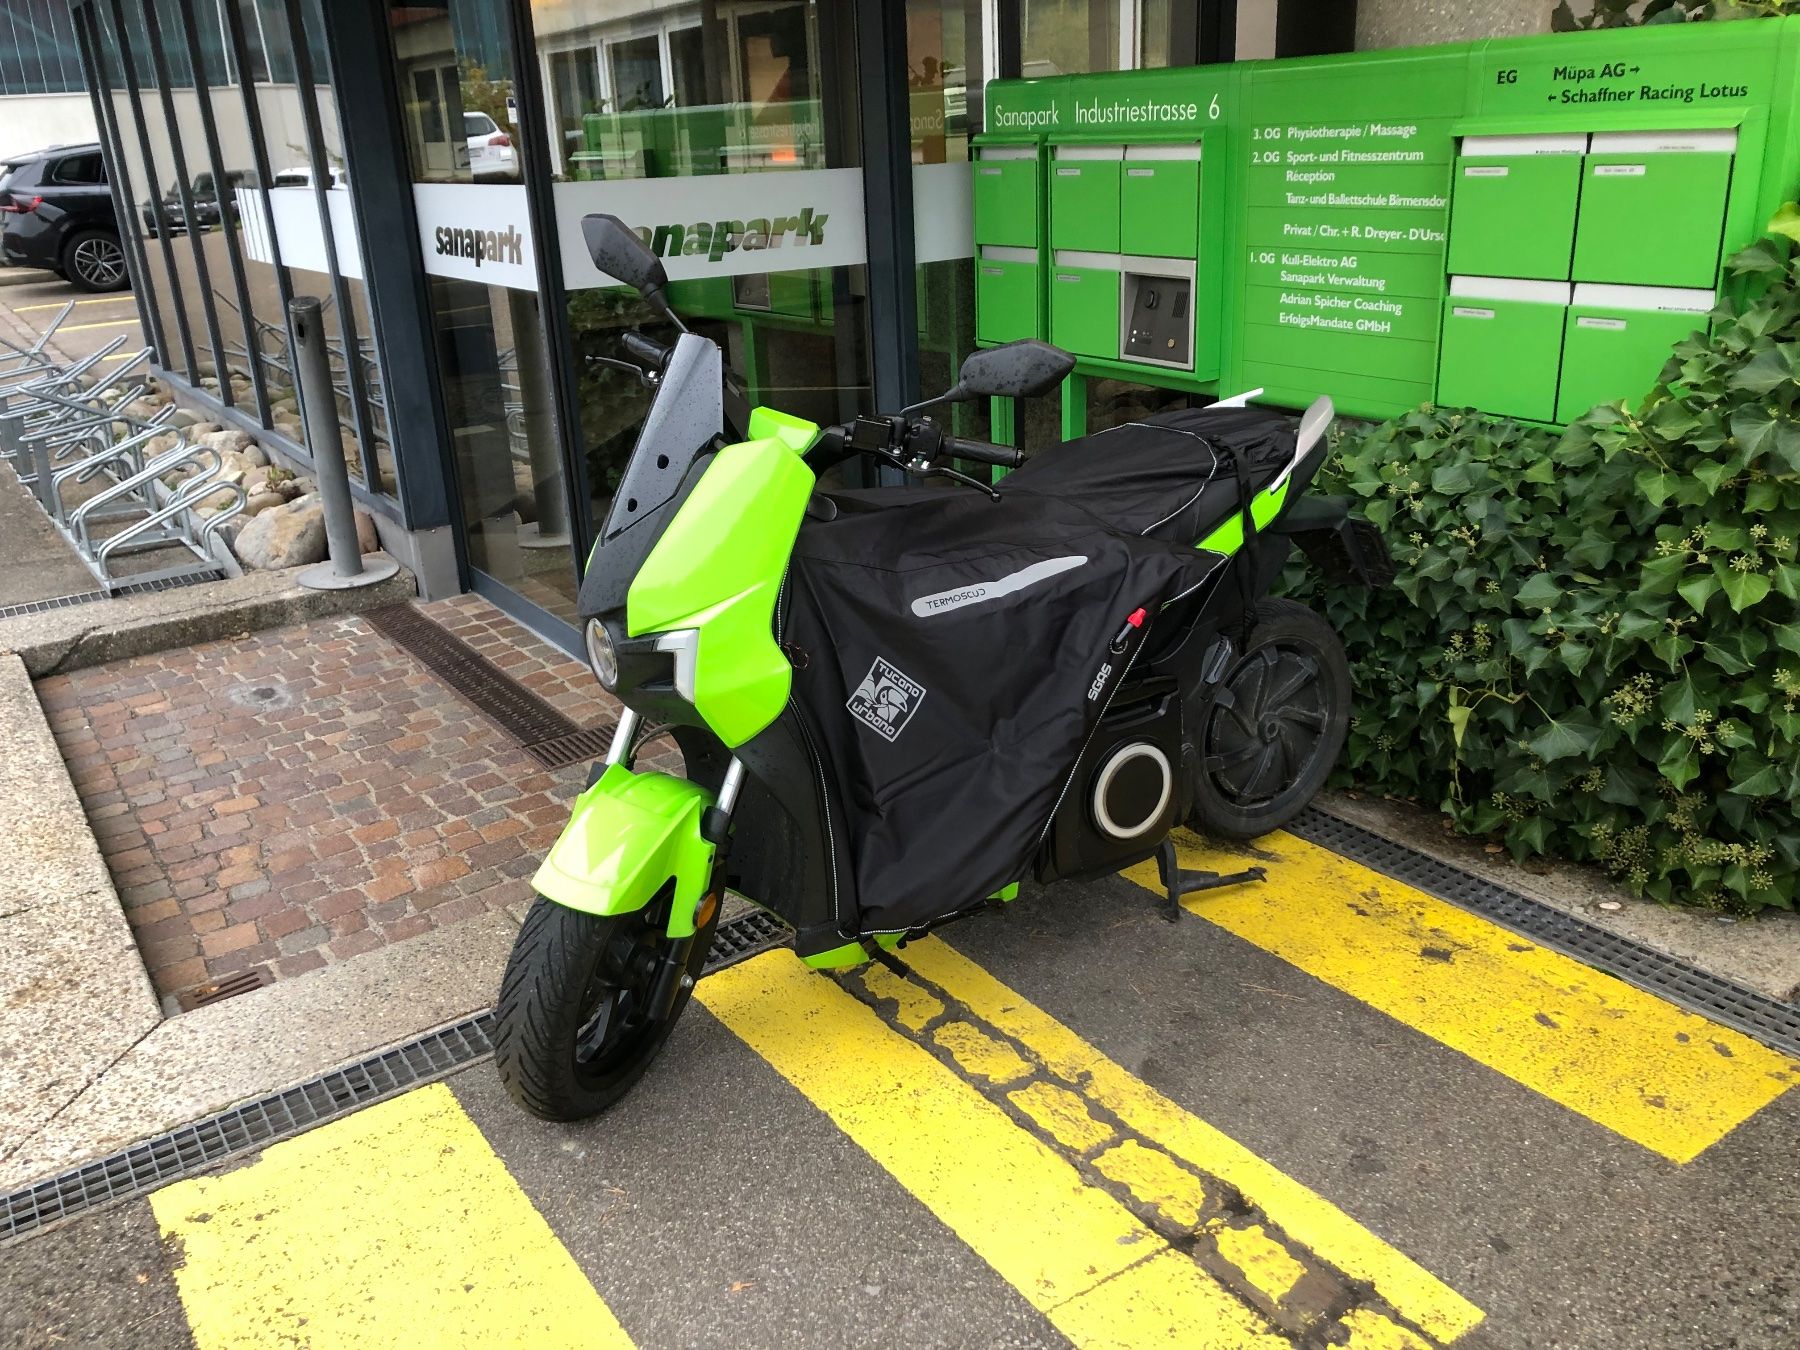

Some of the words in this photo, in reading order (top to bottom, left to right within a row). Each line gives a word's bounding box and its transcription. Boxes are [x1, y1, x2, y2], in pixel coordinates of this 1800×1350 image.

[1496, 70, 1518, 85] EG
[1553, 65, 1596, 84] Müpa
[1600, 62, 1626, 78] AG
[1561, 87, 1635, 104] Schaffner
[1639, 84, 1695, 103] Racing
[1699, 82, 1748, 98] Lotus
[995, 99, 1059, 131] Sanapark
[1075, 97, 1198, 125] Industriestrasse
[1208, 93, 1220, 120] 6
[1253, 128, 1262, 139] 3.
[1264, 127, 1281, 139] OG
[1287, 125, 1362, 141] Physiotherapie
[1363, 125, 1369, 138] /
[1370, 123, 1417, 138] Massage
[1253, 152, 1261, 163] 2.
[1263, 151, 1280, 163] OG
[1287, 151, 1317, 165] Sport-
[1319, 150, 1339, 162] und
[1341, 150, 1424, 162] Fitnesszentrum
[1286, 192, 1309, 204] Tanz-
[1310, 193, 1327, 205] und
[1328, 193, 1387, 206] Ballettschule
[1388, 194, 1446, 207] Birmensdor
[631, 207, 828, 262] napark
[1284, 223, 1312, 236] Privat
[1319, 224, 1340, 237] Chr.
[1342, 228, 1350, 236] +
[1351, 225, 1361, 238] R.
[1364, 226, 1402, 242] Dreyer
[435, 224, 522, 267] sanapark
[1259, 252, 1275, 264] OG
[1282, 253, 1338, 268] Kull-Elektro
[1340, 256, 1357, 268] AG
[1280, 270, 1325, 285] Sanapark
[1327, 273, 1386, 291] Verwaltung
[1280, 292, 1312, 305] Adrian
[1314, 295, 1351, 312] Spicher
[1354, 299, 1403, 316] Coaching
[1356, 319, 1391, 333] GMbH
